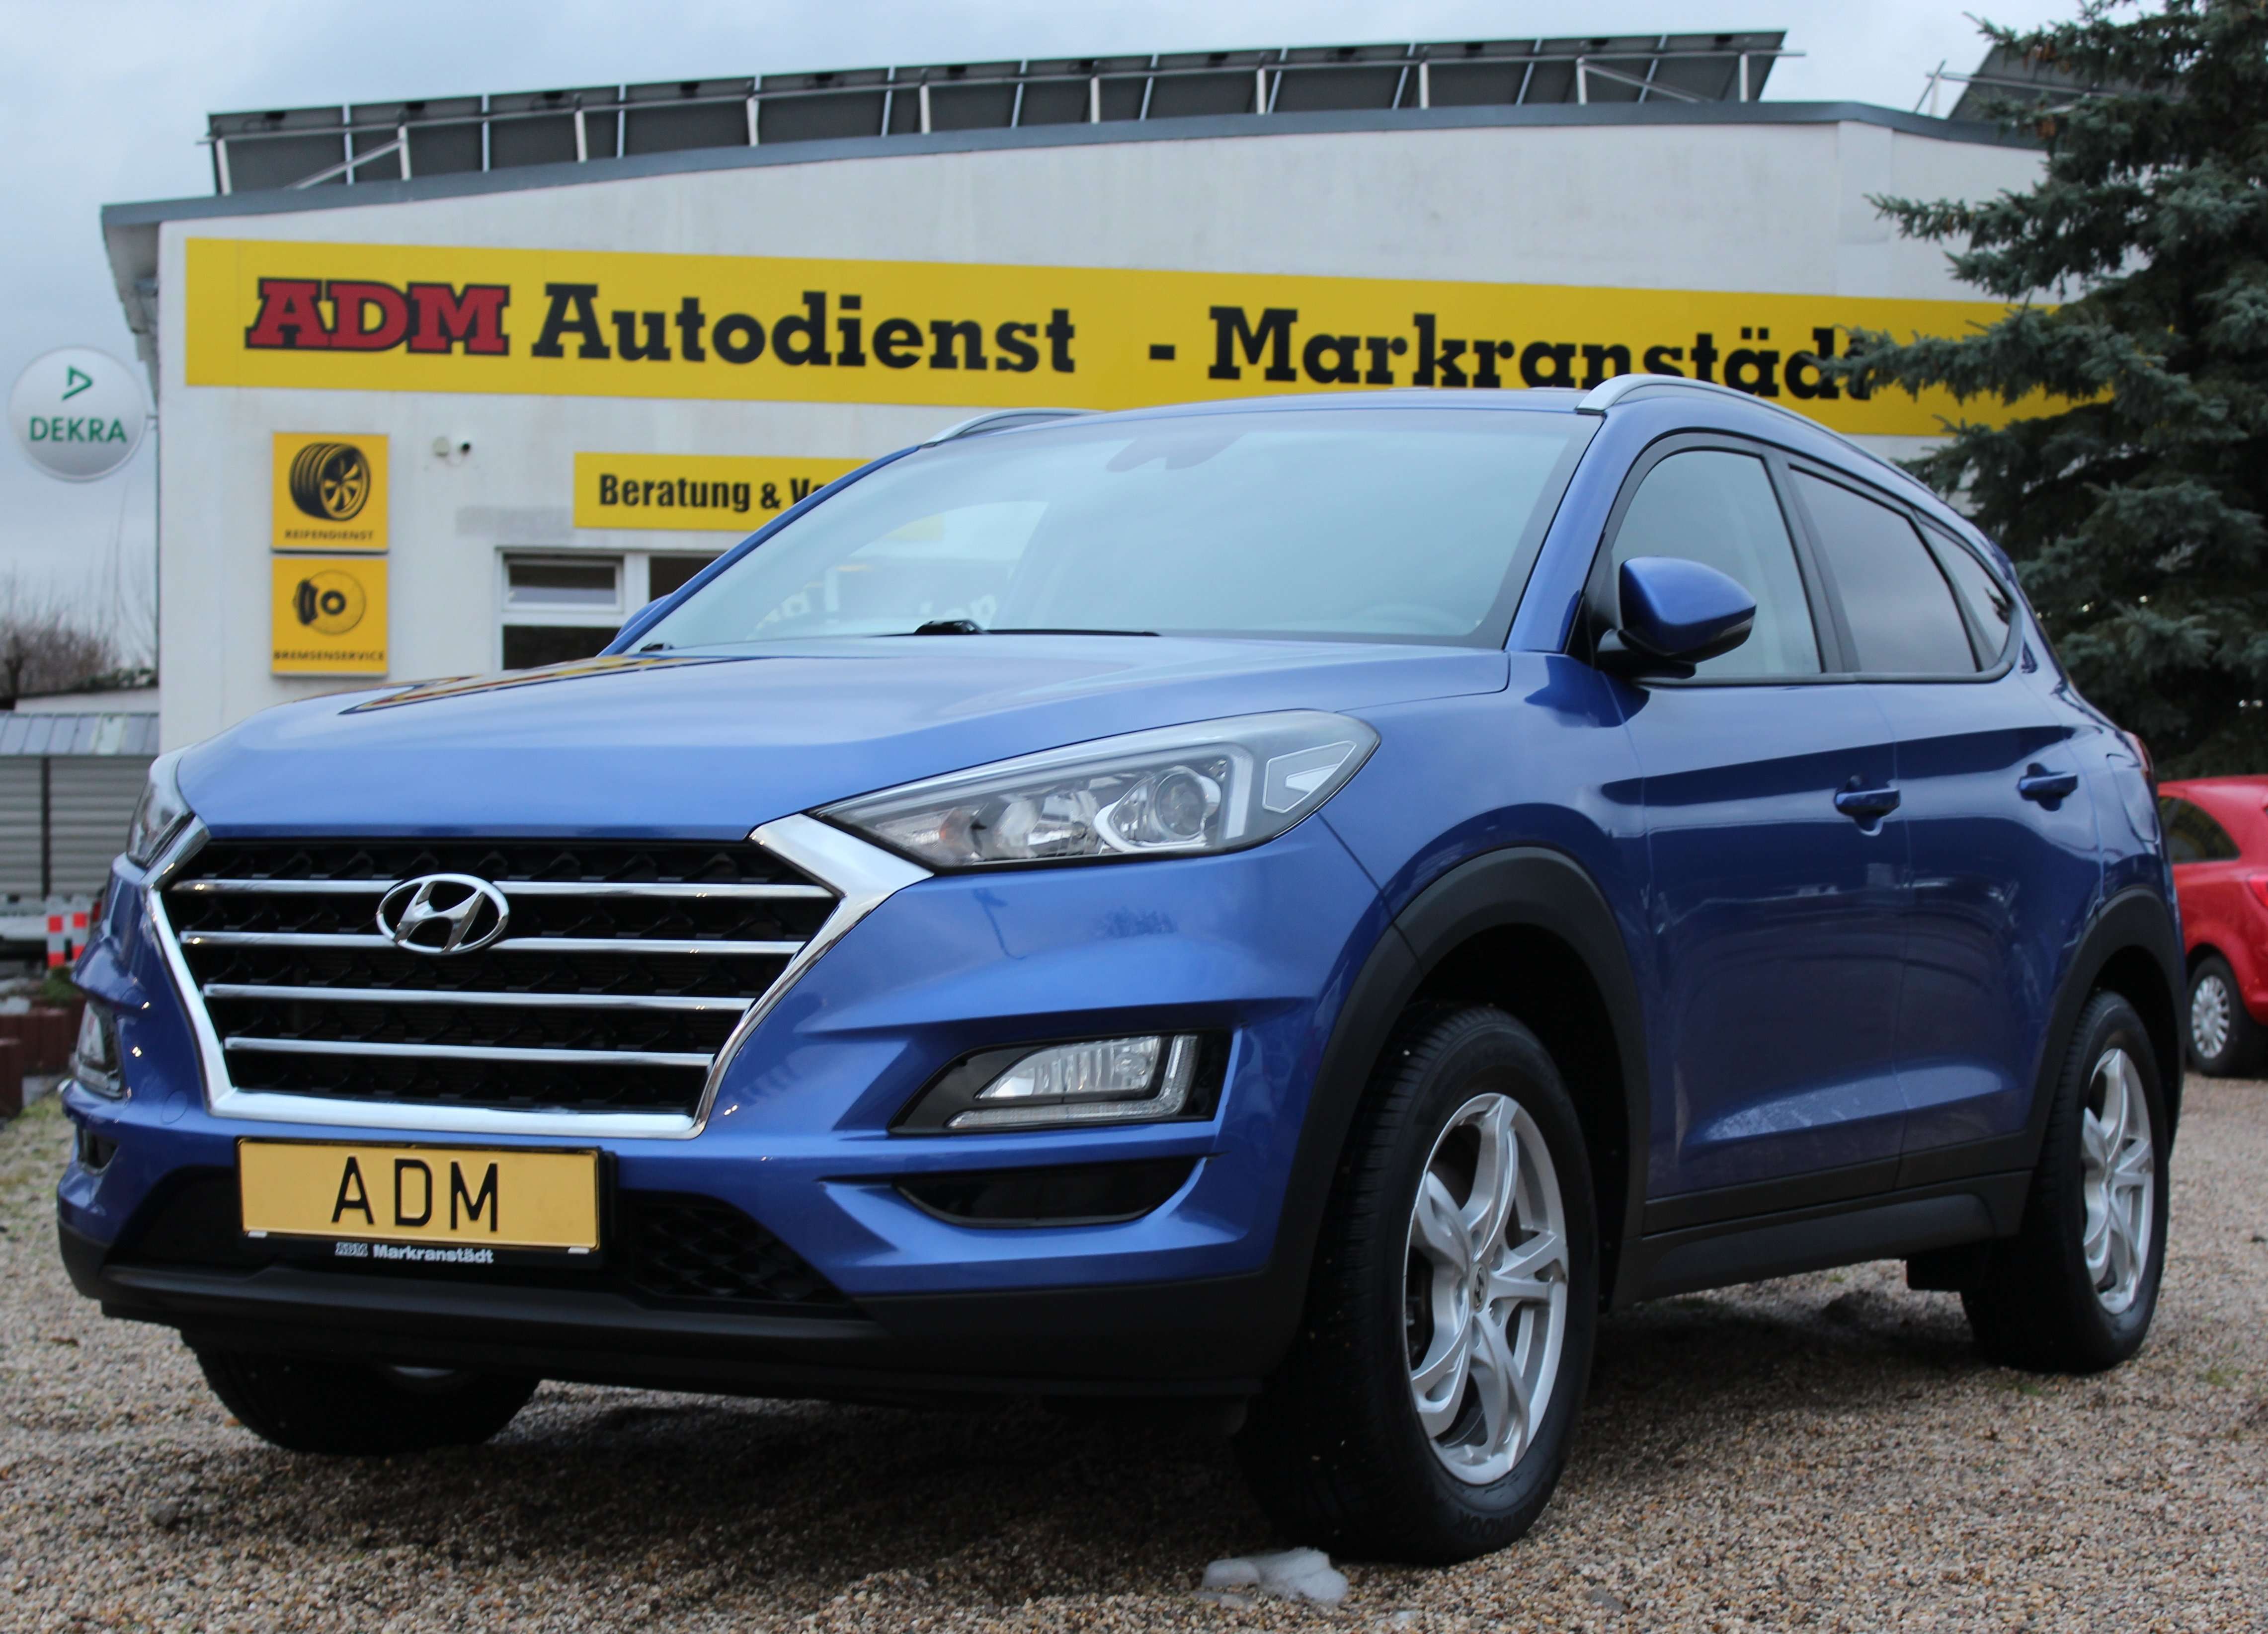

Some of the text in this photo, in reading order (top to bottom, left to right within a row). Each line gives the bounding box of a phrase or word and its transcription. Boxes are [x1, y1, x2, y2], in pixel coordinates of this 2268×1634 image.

[244, 277, 510, 356] ADM
[532, 283, 1076, 374] Autodienst
[29, 415, 128, 444] DEKRA
[599, 473, 826, 513] Beratung & V
[273, 650, 385, 662] BREMSENSERVICE
[331, 1156, 498, 1232] ADM
[373, 1244, 493, 1263] Markranstädt
